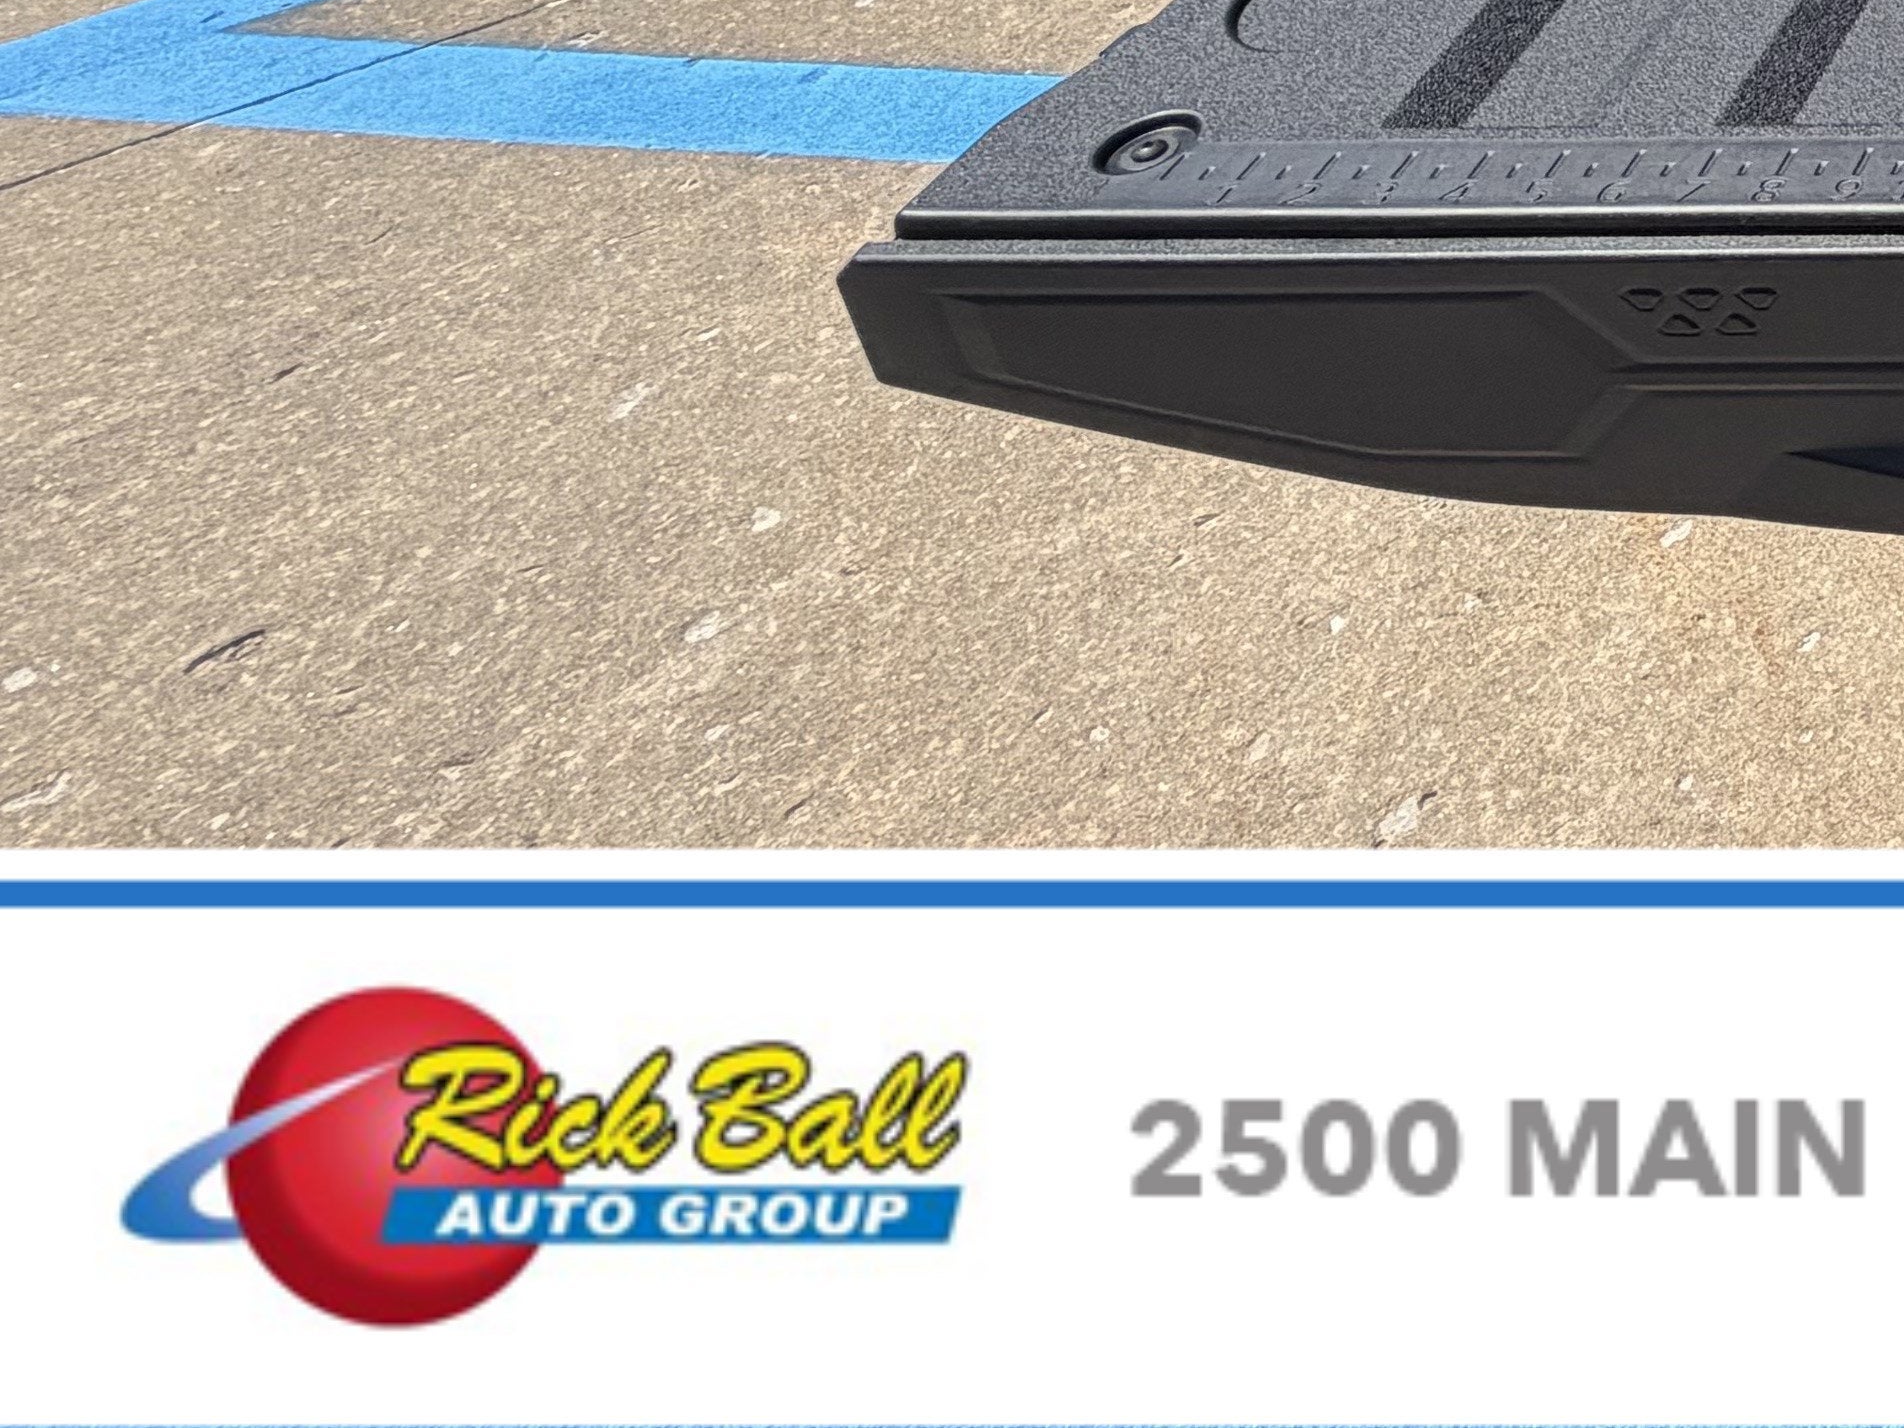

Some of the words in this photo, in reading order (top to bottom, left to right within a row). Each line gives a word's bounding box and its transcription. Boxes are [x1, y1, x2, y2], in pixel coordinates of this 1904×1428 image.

[1205, 184, 1238, 205] 1
[1278, 182, 1322, 205] 2
[1361, 181, 1399, 204] 3
[1438, 179, 1480, 204] 4
[1517, 178, 1552, 204] 5
[1597, 178, 1631, 203] 6
[1676, 178, 1711, 202] 7
[1751, 178, 1786, 202] 8
[1830, 178, 1863, 201] 9
